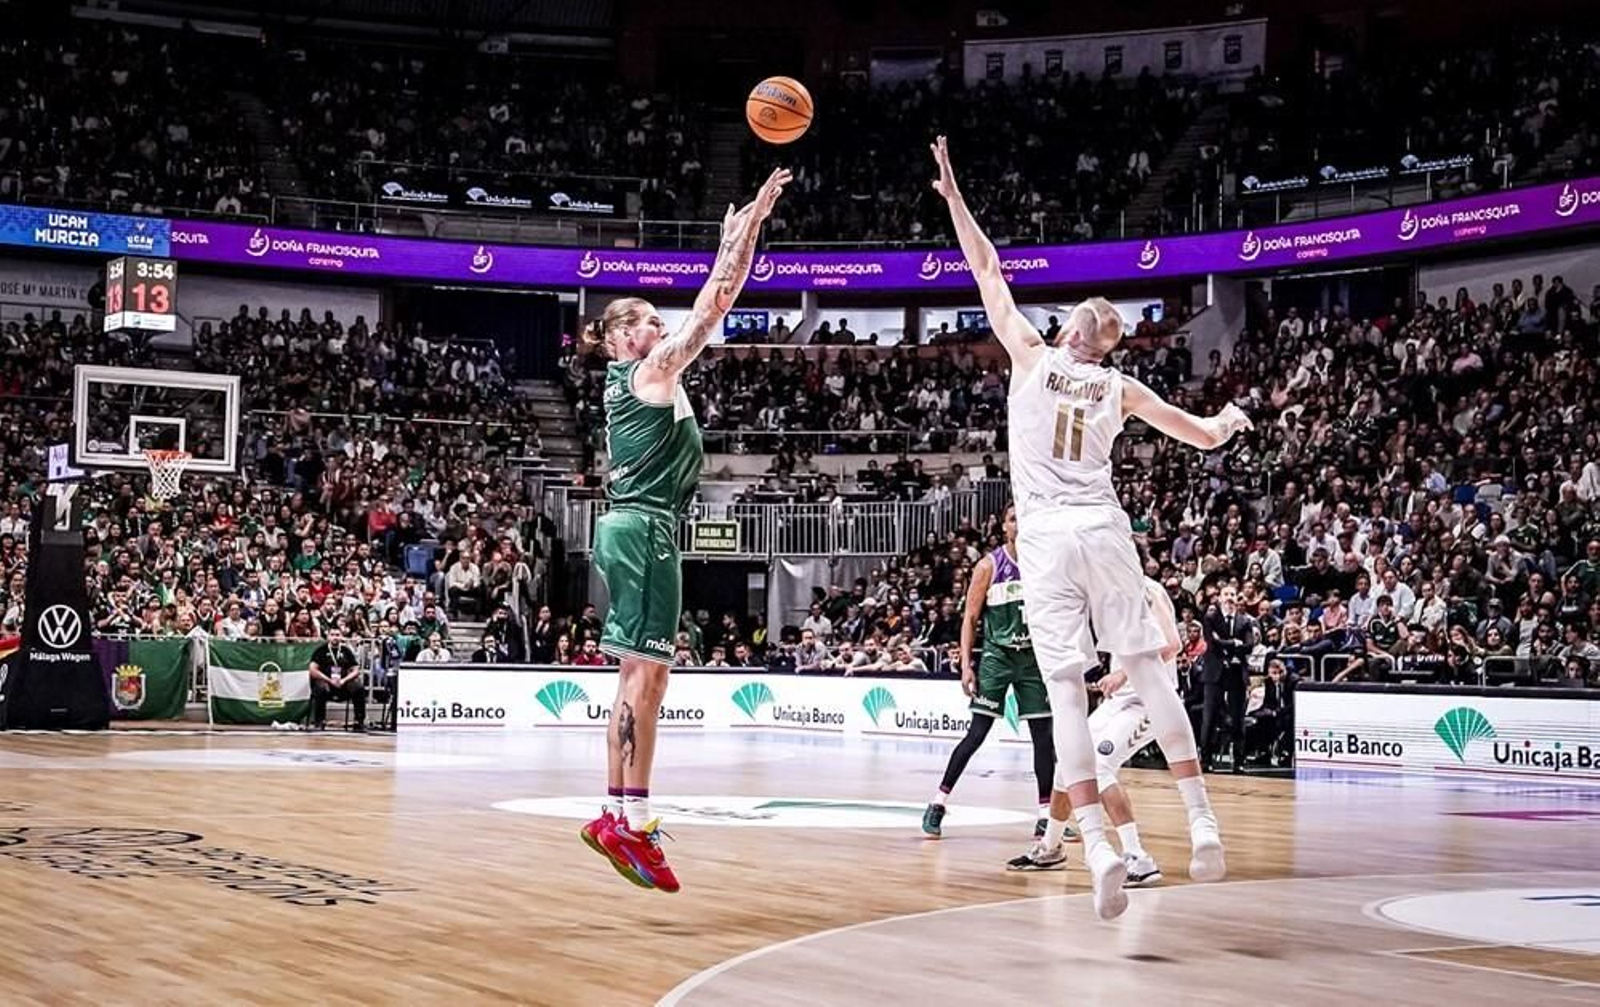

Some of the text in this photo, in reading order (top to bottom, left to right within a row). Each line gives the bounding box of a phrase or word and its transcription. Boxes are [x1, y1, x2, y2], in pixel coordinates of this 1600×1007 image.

[1582, 191, 1600, 204] DO
[48, 214, 88, 229] UCAM
[1421, 204, 1520, 229] DOÑA FRANCISQUITA
[35, 228, 99, 247] MURCIA
[127, 235, 154, 245] UCAM
[171, 231, 209, 244] SQUITA
[1263, 228, 1361, 251] DOÑA FRANCISQUITA
[272, 239, 379, 258] DOÑA FRANCISQUITA
[137, 262, 174, 279] 3:54
[603, 260, 709, 274] DOÑA FRANCISQUITA
[777, 262, 808, 274] DOÑA
[944, 260, 972, 271] DOÑ
[132, 282, 169, 313] 13
[1053, 403, 1085, 461] 11
[30, 652, 90, 663] Málaga Wagen
[452, 702, 505, 719] Banco
[773, 704, 844, 725] Unicaja Banco
[895, 710, 940, 734] Unicaja
[1347, 734, 1403, 757] Banco
[1494, 740, 1573, 772] Unicaja
